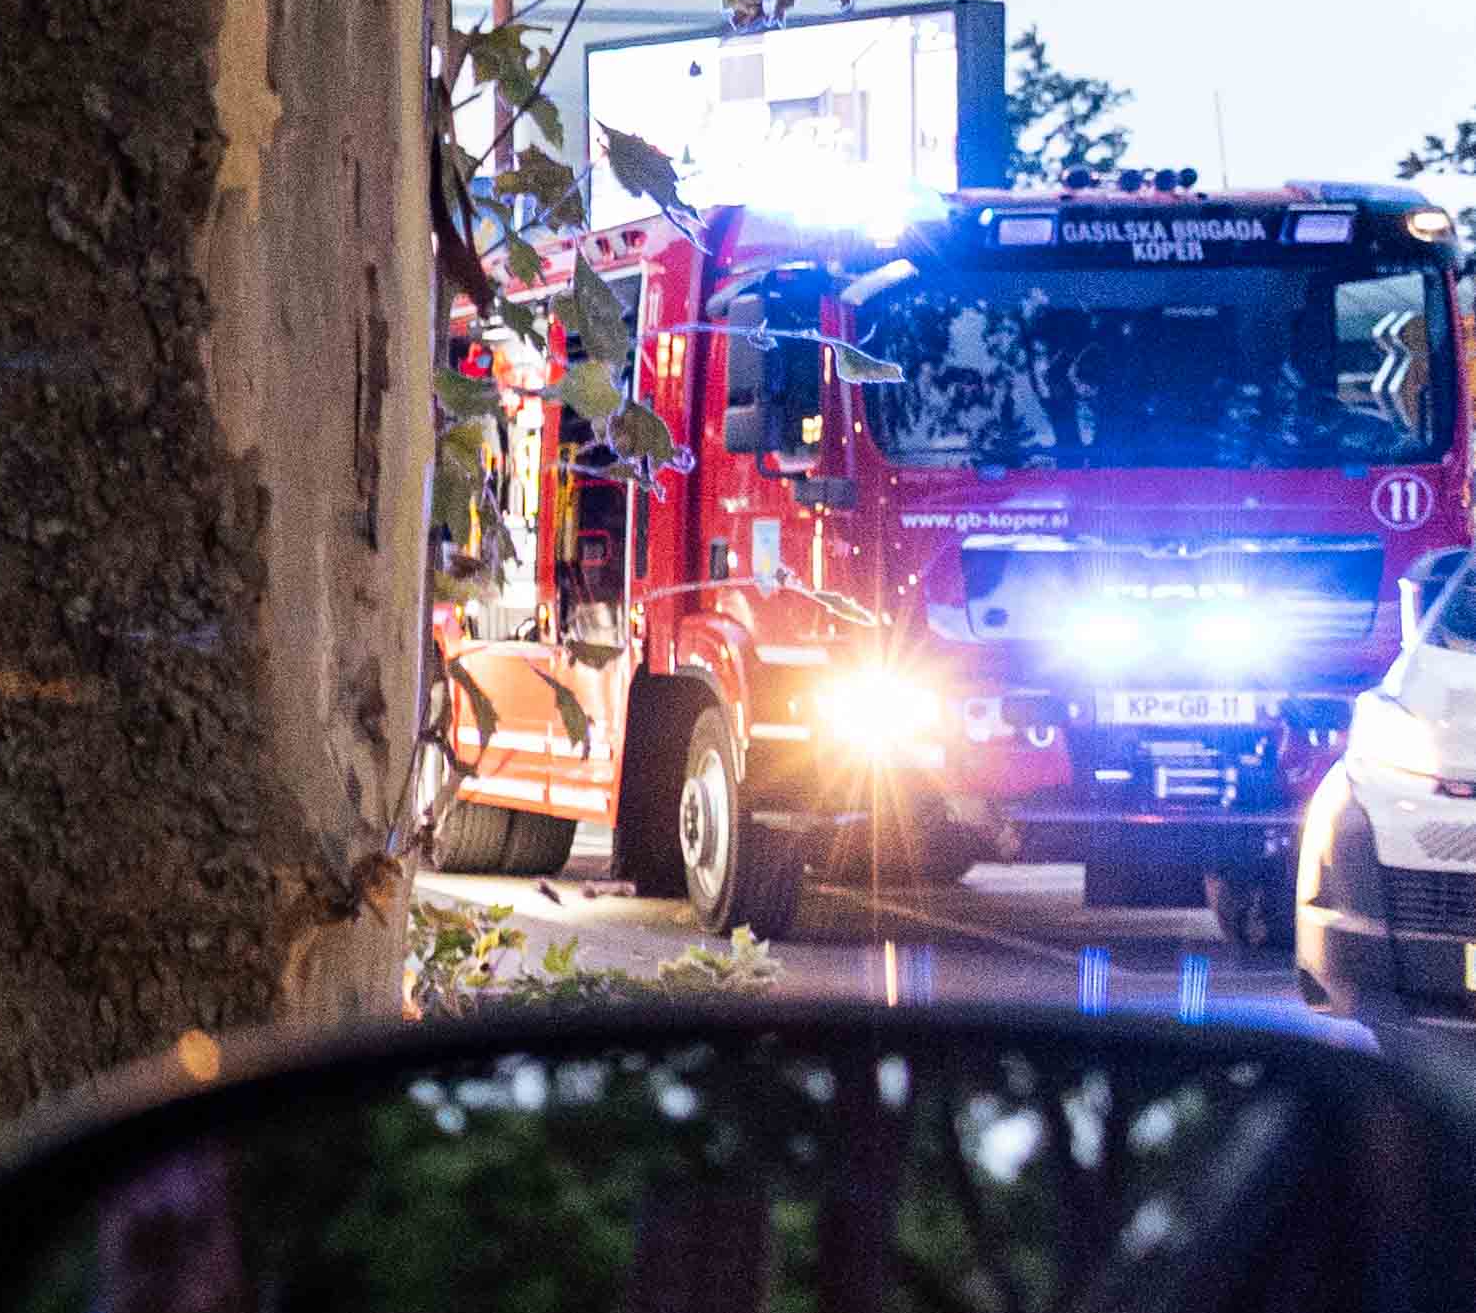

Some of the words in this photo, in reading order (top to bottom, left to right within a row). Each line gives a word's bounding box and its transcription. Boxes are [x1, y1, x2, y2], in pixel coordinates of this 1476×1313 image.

[1062, 220, 1167, 241] GASILSKA
[1171, 218, 1267, 240] BRIGADA
[1133, 241, 1204, 262] KOPER
[1389, 480, 1418, 521] 11
[901, 511, 1068, 533] www.gb-koper.si
